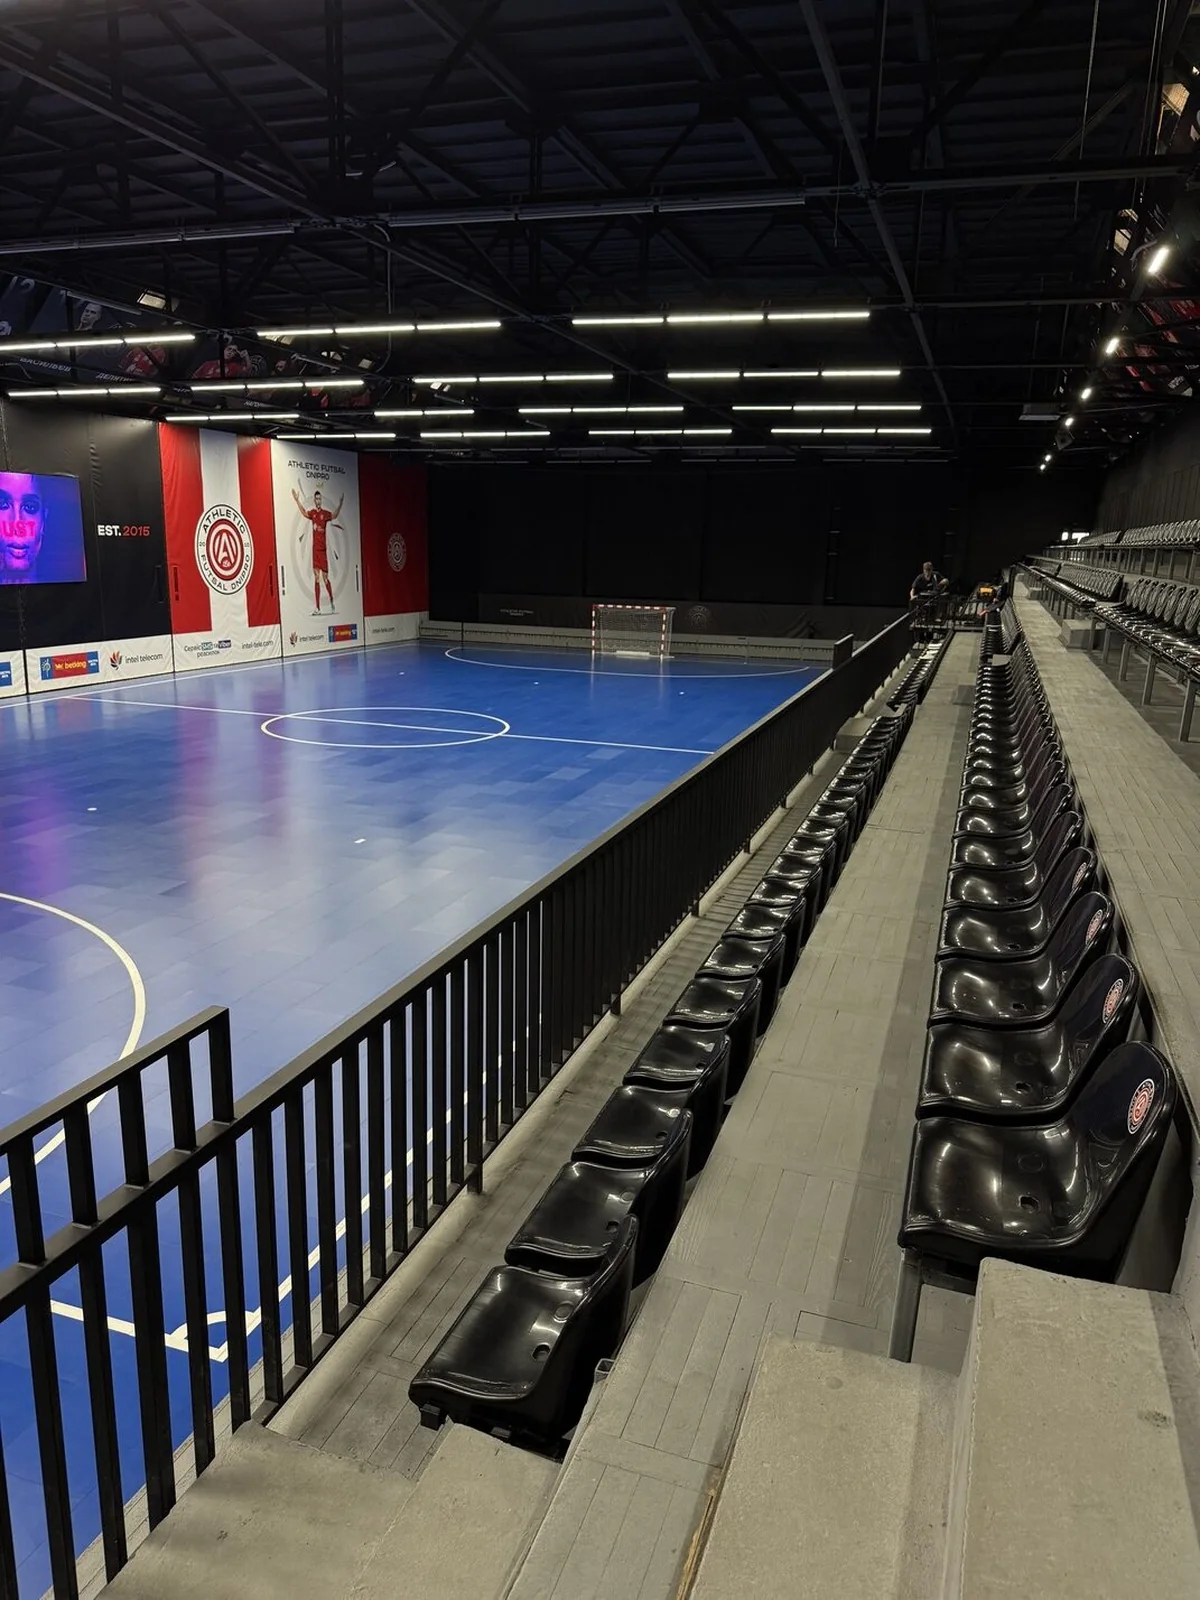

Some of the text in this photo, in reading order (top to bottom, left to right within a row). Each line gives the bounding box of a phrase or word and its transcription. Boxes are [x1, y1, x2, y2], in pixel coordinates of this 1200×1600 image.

[288, 460, 320, 471] ATHLETIC
[306, 471, 330, 481] DNIPRO
[202, 508, 246, 534] ATHLETIC
[0, 520, 36, 538] UST
[97, 525, 150, 536] EST. 2015
[201, 554, 251, 591] FUTSAL DNIPRO
